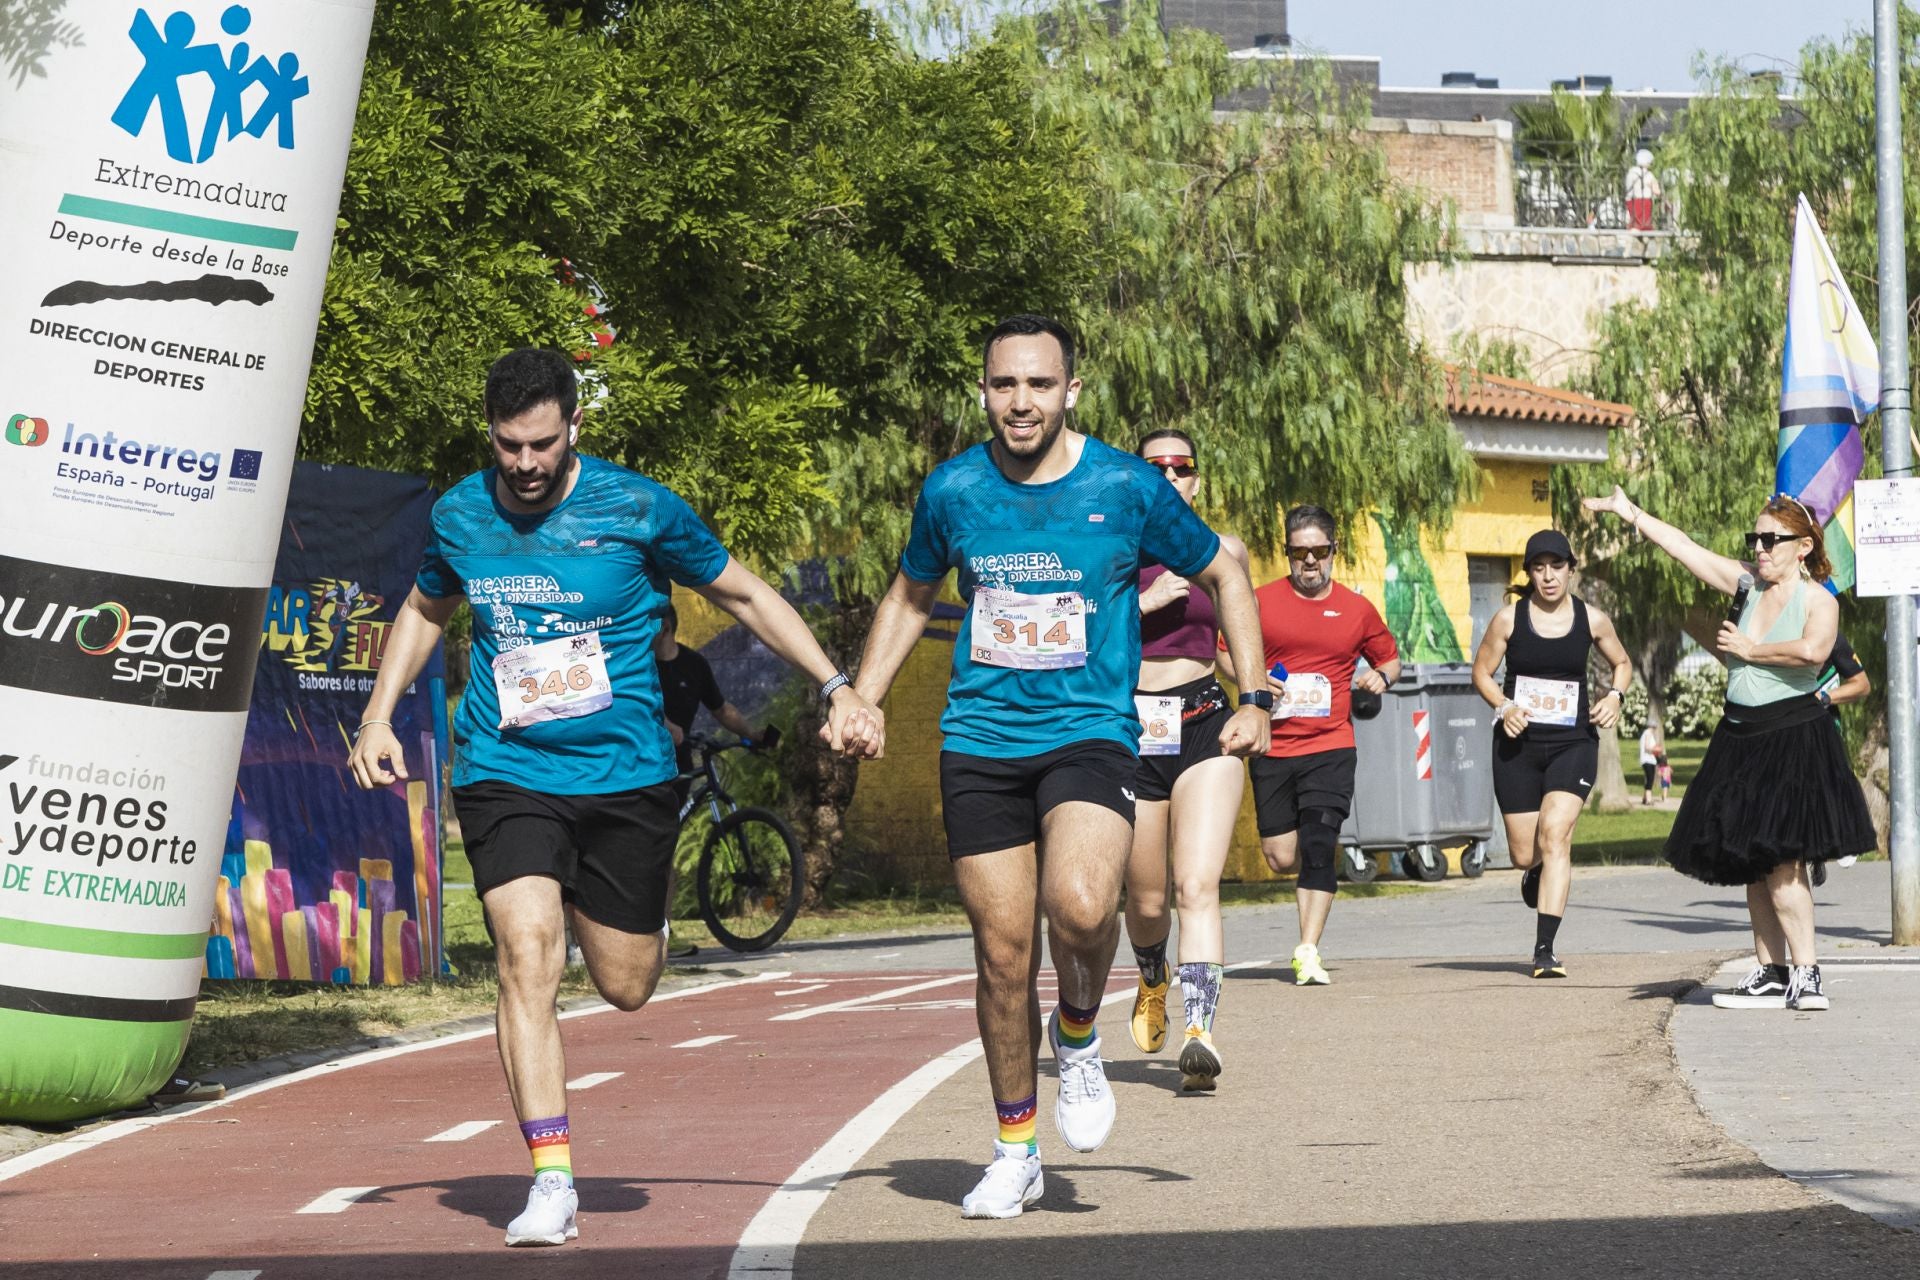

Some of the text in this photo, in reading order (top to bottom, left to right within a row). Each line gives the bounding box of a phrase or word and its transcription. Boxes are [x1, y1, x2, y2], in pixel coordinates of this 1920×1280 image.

[94, 158, 288, 213] Extremadura
[49, 220, 289, 278] Deporte desde la Base
[29, 318, 266, 371] DIRECCION GENERAL DE
[93, 359, 205, 391] DEPORTES
[62, 422, 222, 482] Interreg
[57, 462, 124, 488] España
[143, 477, 215, 502] Portugal
[985, 552, 1062, 571] CARRERA
[1008, 569, 1082, 582] DIVERSIDAD
[482, 576, 559, 593] CARRERA
[505, 592, 583, 604] DIVERSIDAD
[0, 594, 231, 662] uroace
[554, 616, 613, 634] aqualia
[993, 618, 1071, 647] 314
[1002, 612, 1028, 621] aqualia
[112, 658, 222, 690] SPORT
[298, 673, 341, 692] Sabores
[343, 675, 356, 691] de
[519, 664, 593, 704] 346
[1528, 694, 1569, 711] 381
[28, 754, 166, 791] fundación
[9, 782, 168, 831] venes
[8, 821, 197, 867] ydeporte
[2, 864, 187, 907] DE EXTREMADURA
